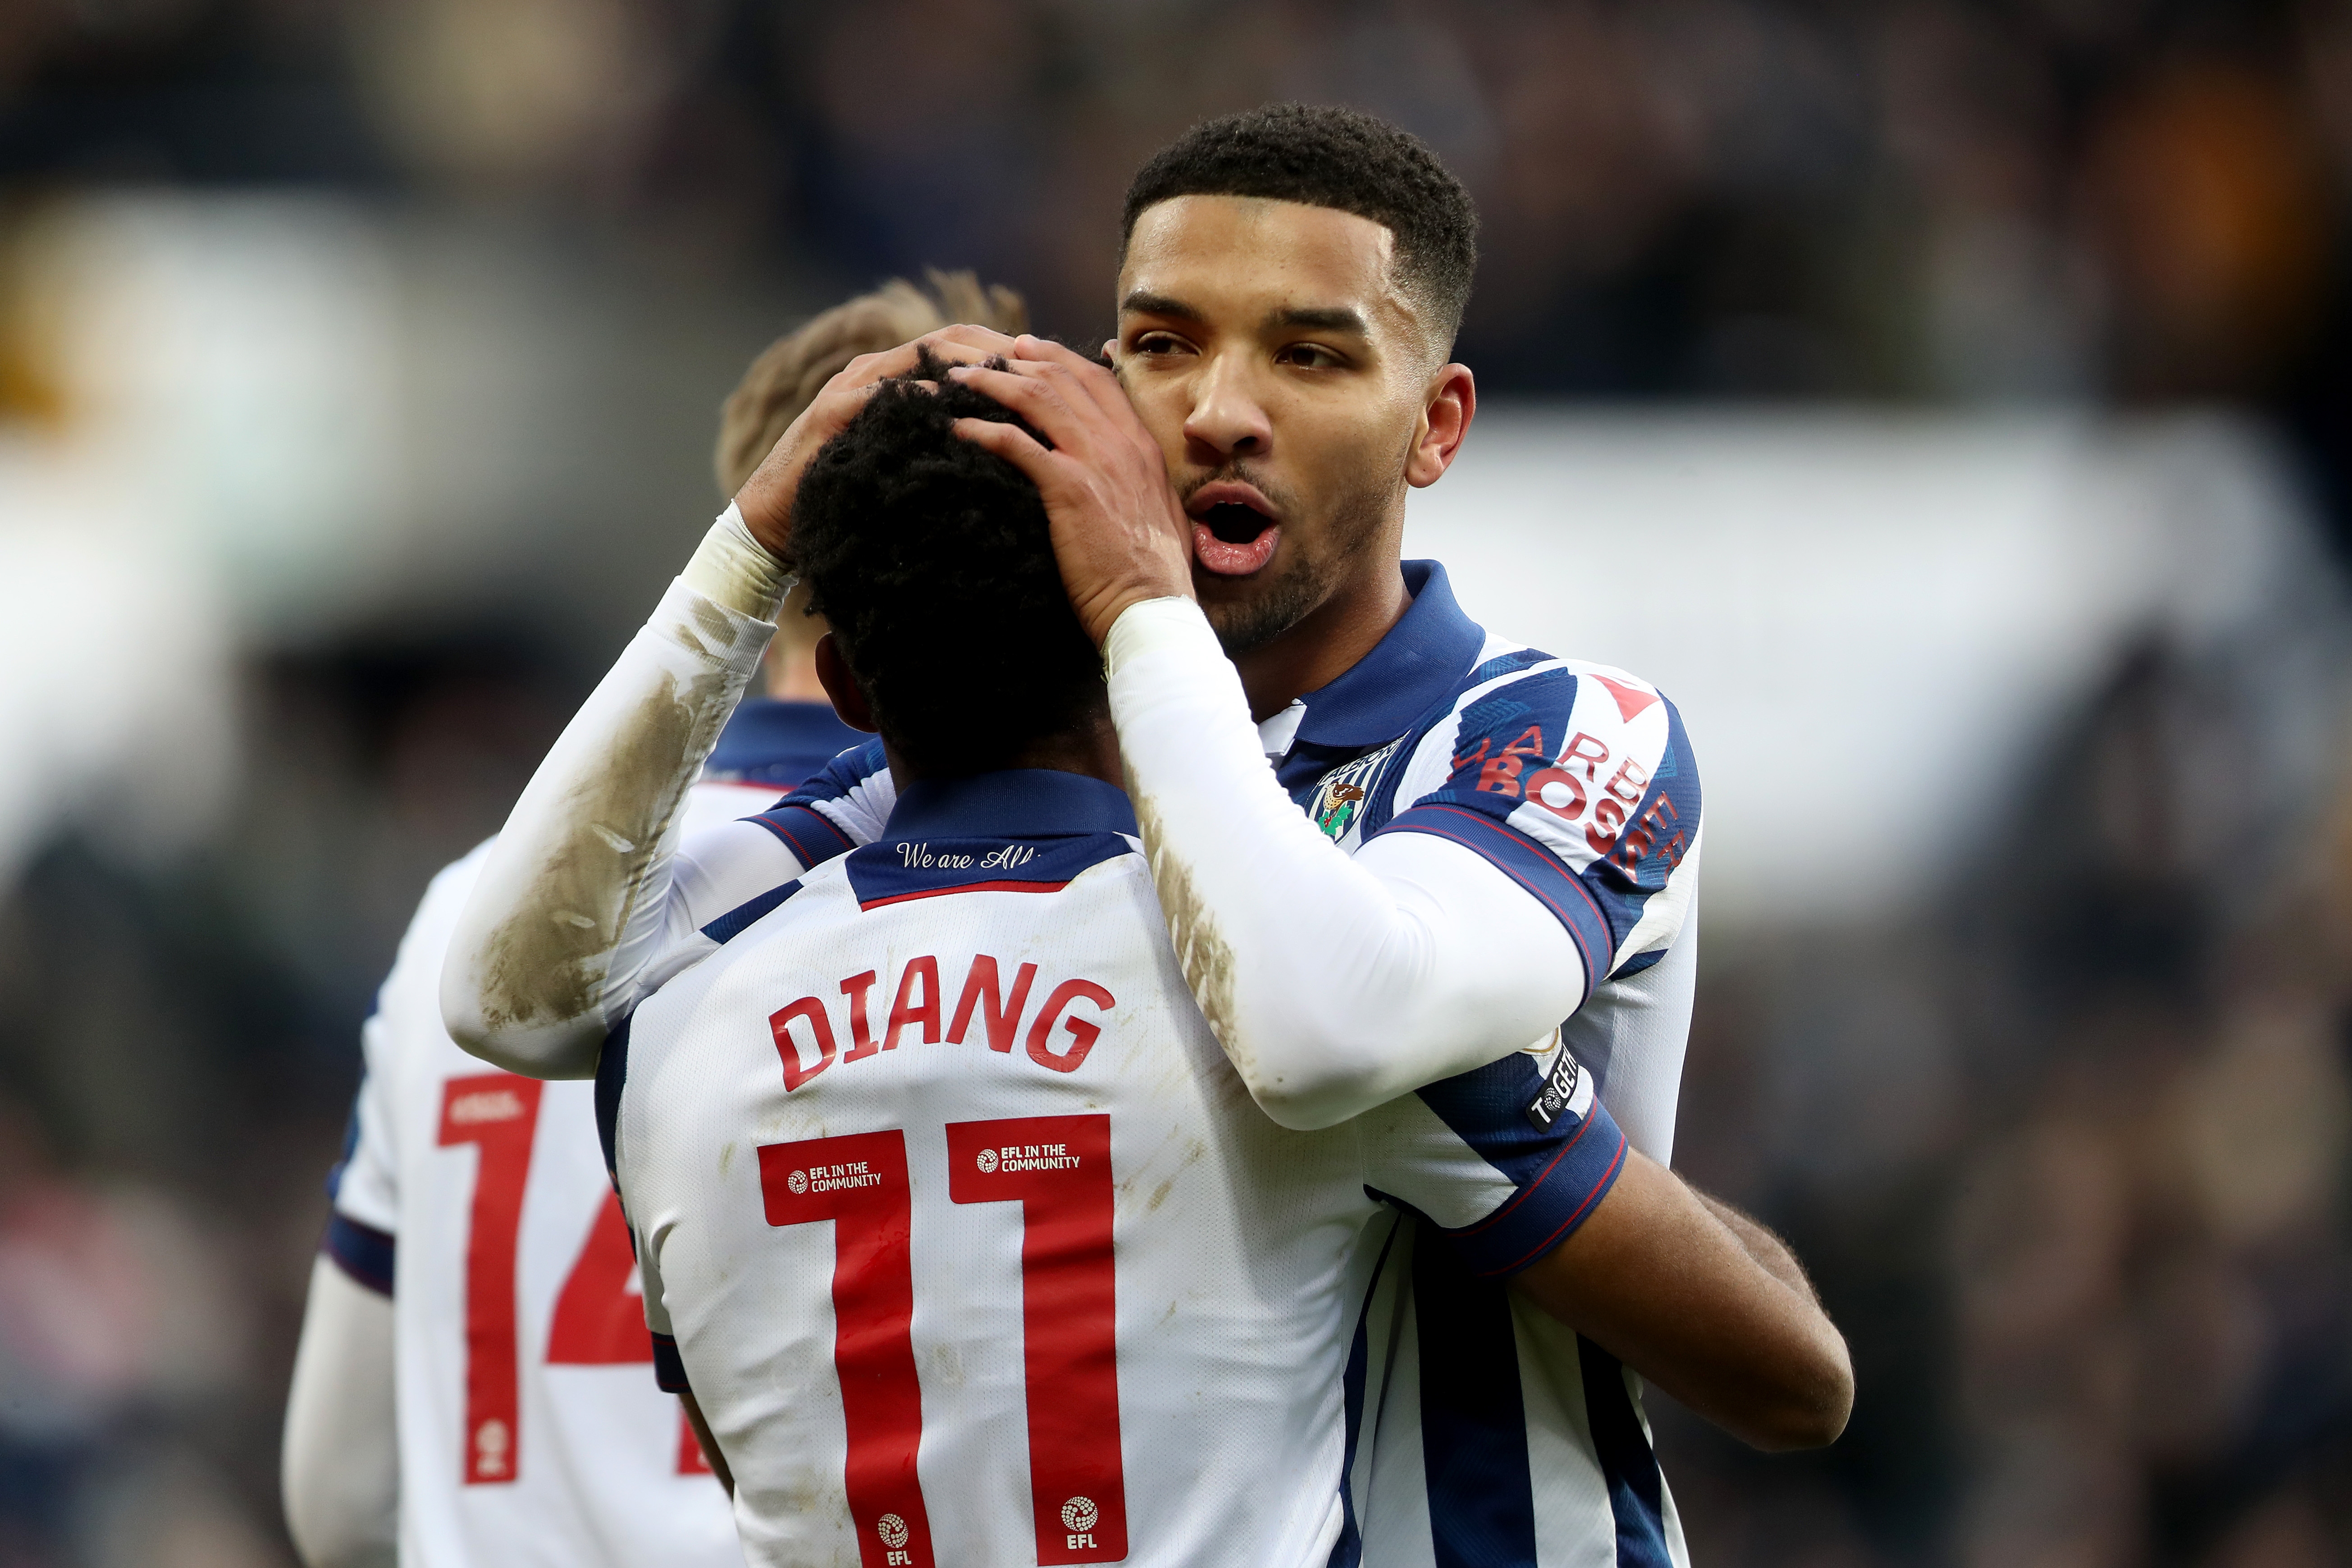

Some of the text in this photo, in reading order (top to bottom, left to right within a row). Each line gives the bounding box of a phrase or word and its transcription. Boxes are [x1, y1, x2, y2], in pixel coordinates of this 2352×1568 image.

[1475, 755, 1648, 883] BOSS
[896, 842, 936, 869] We
[937, 855, 975, 869] are
[768, 954, 1116, 1093] DIANG
[1001, 1144, 1066, 1159] EFL IN THE
[809, 1161, 868, 1179] EFL IN THE
[1001, 1156, 1080, 1172] COMMUNITY
[811, 1173, 881, 1193] COMMUNITY
[757, 1114, 1129, 1568] 11
[1067, 1534, 1097, 1550] EFL
[886, 1550, 912, 1566] EFL
